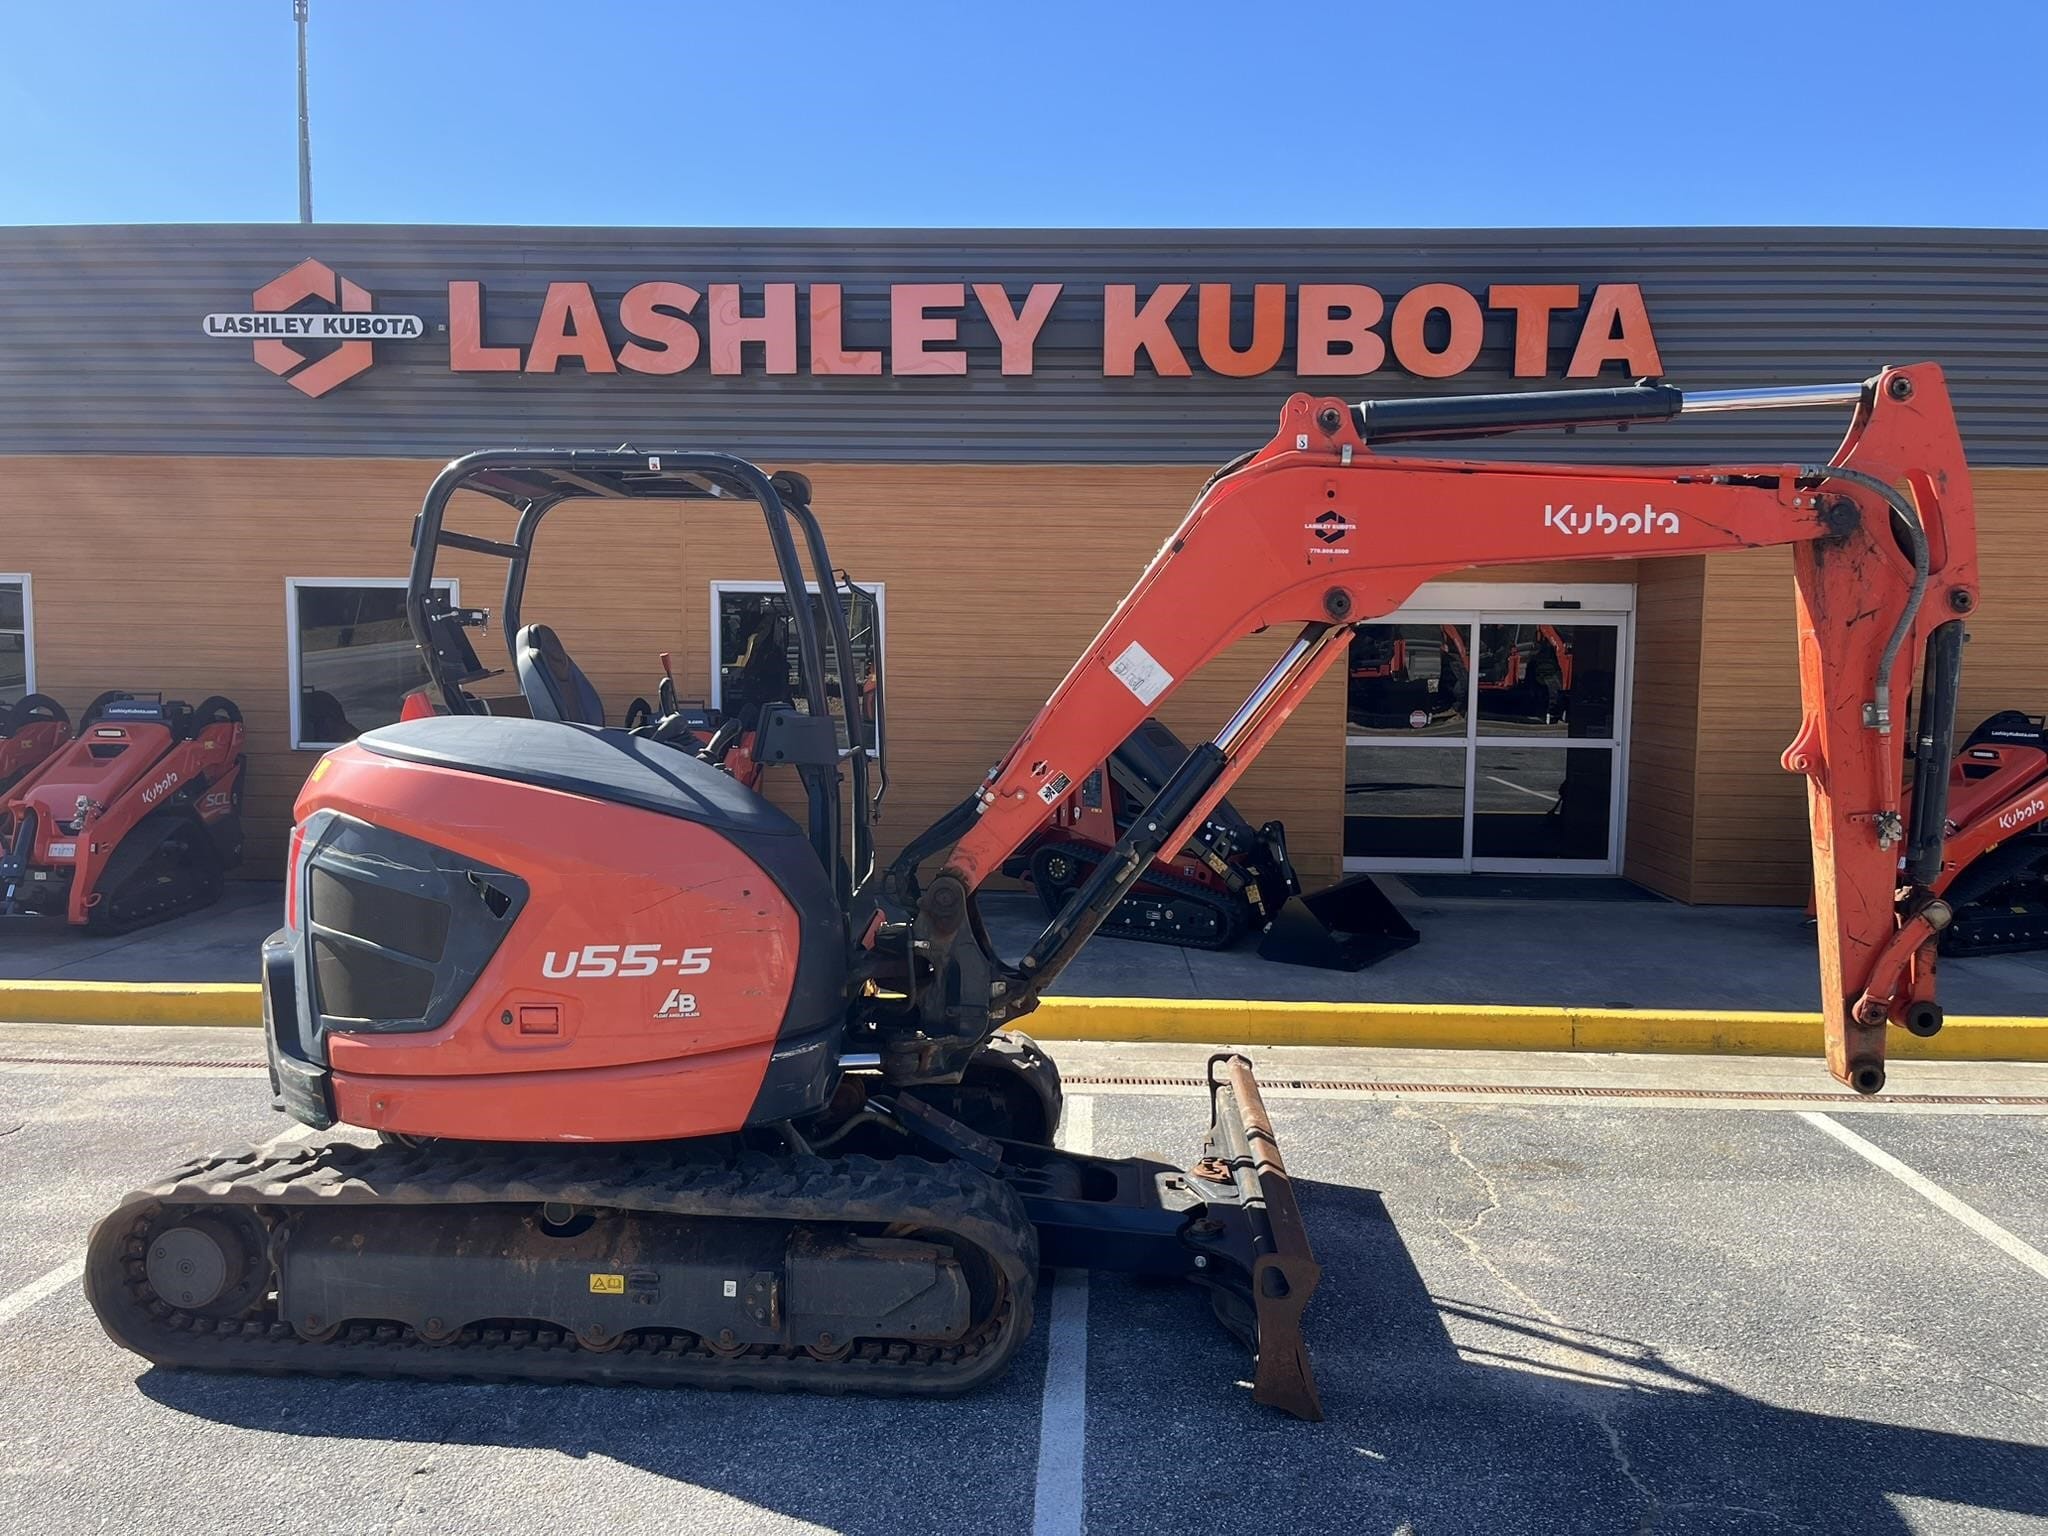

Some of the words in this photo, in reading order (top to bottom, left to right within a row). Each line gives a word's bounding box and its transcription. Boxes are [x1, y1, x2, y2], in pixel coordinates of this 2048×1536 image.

[209, 316, 314, 333] LASHLEY
[323, 318, 418, 335] KUBOTA
[447, 280, 1064, 375] LASHLEY
[1103, 282, 1665, 378] KUBOTA
[1544, 503, 1680, 535] Kubota
[142, 772, 178, 803] Kubota
[1999, 800, 2045, 829] Kubota
